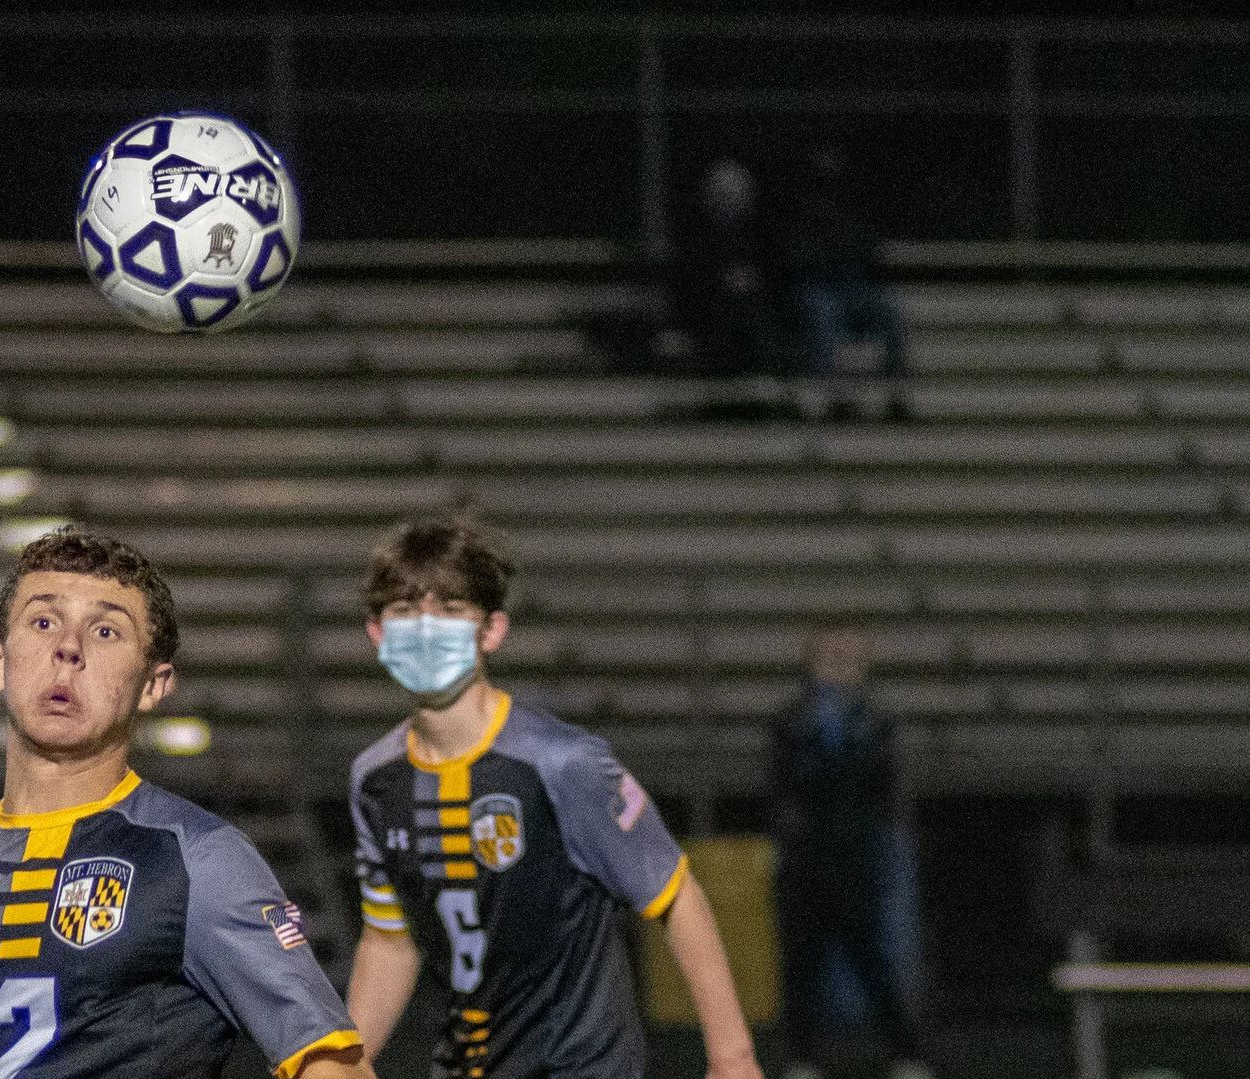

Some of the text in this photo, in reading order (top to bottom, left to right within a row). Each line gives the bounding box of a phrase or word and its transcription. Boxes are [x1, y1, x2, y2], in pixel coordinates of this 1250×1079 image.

[150, 172, 281, 209] BRINE
[87, 862, 129, 882] HEBRON
[437, 889, 487, 993] 6
